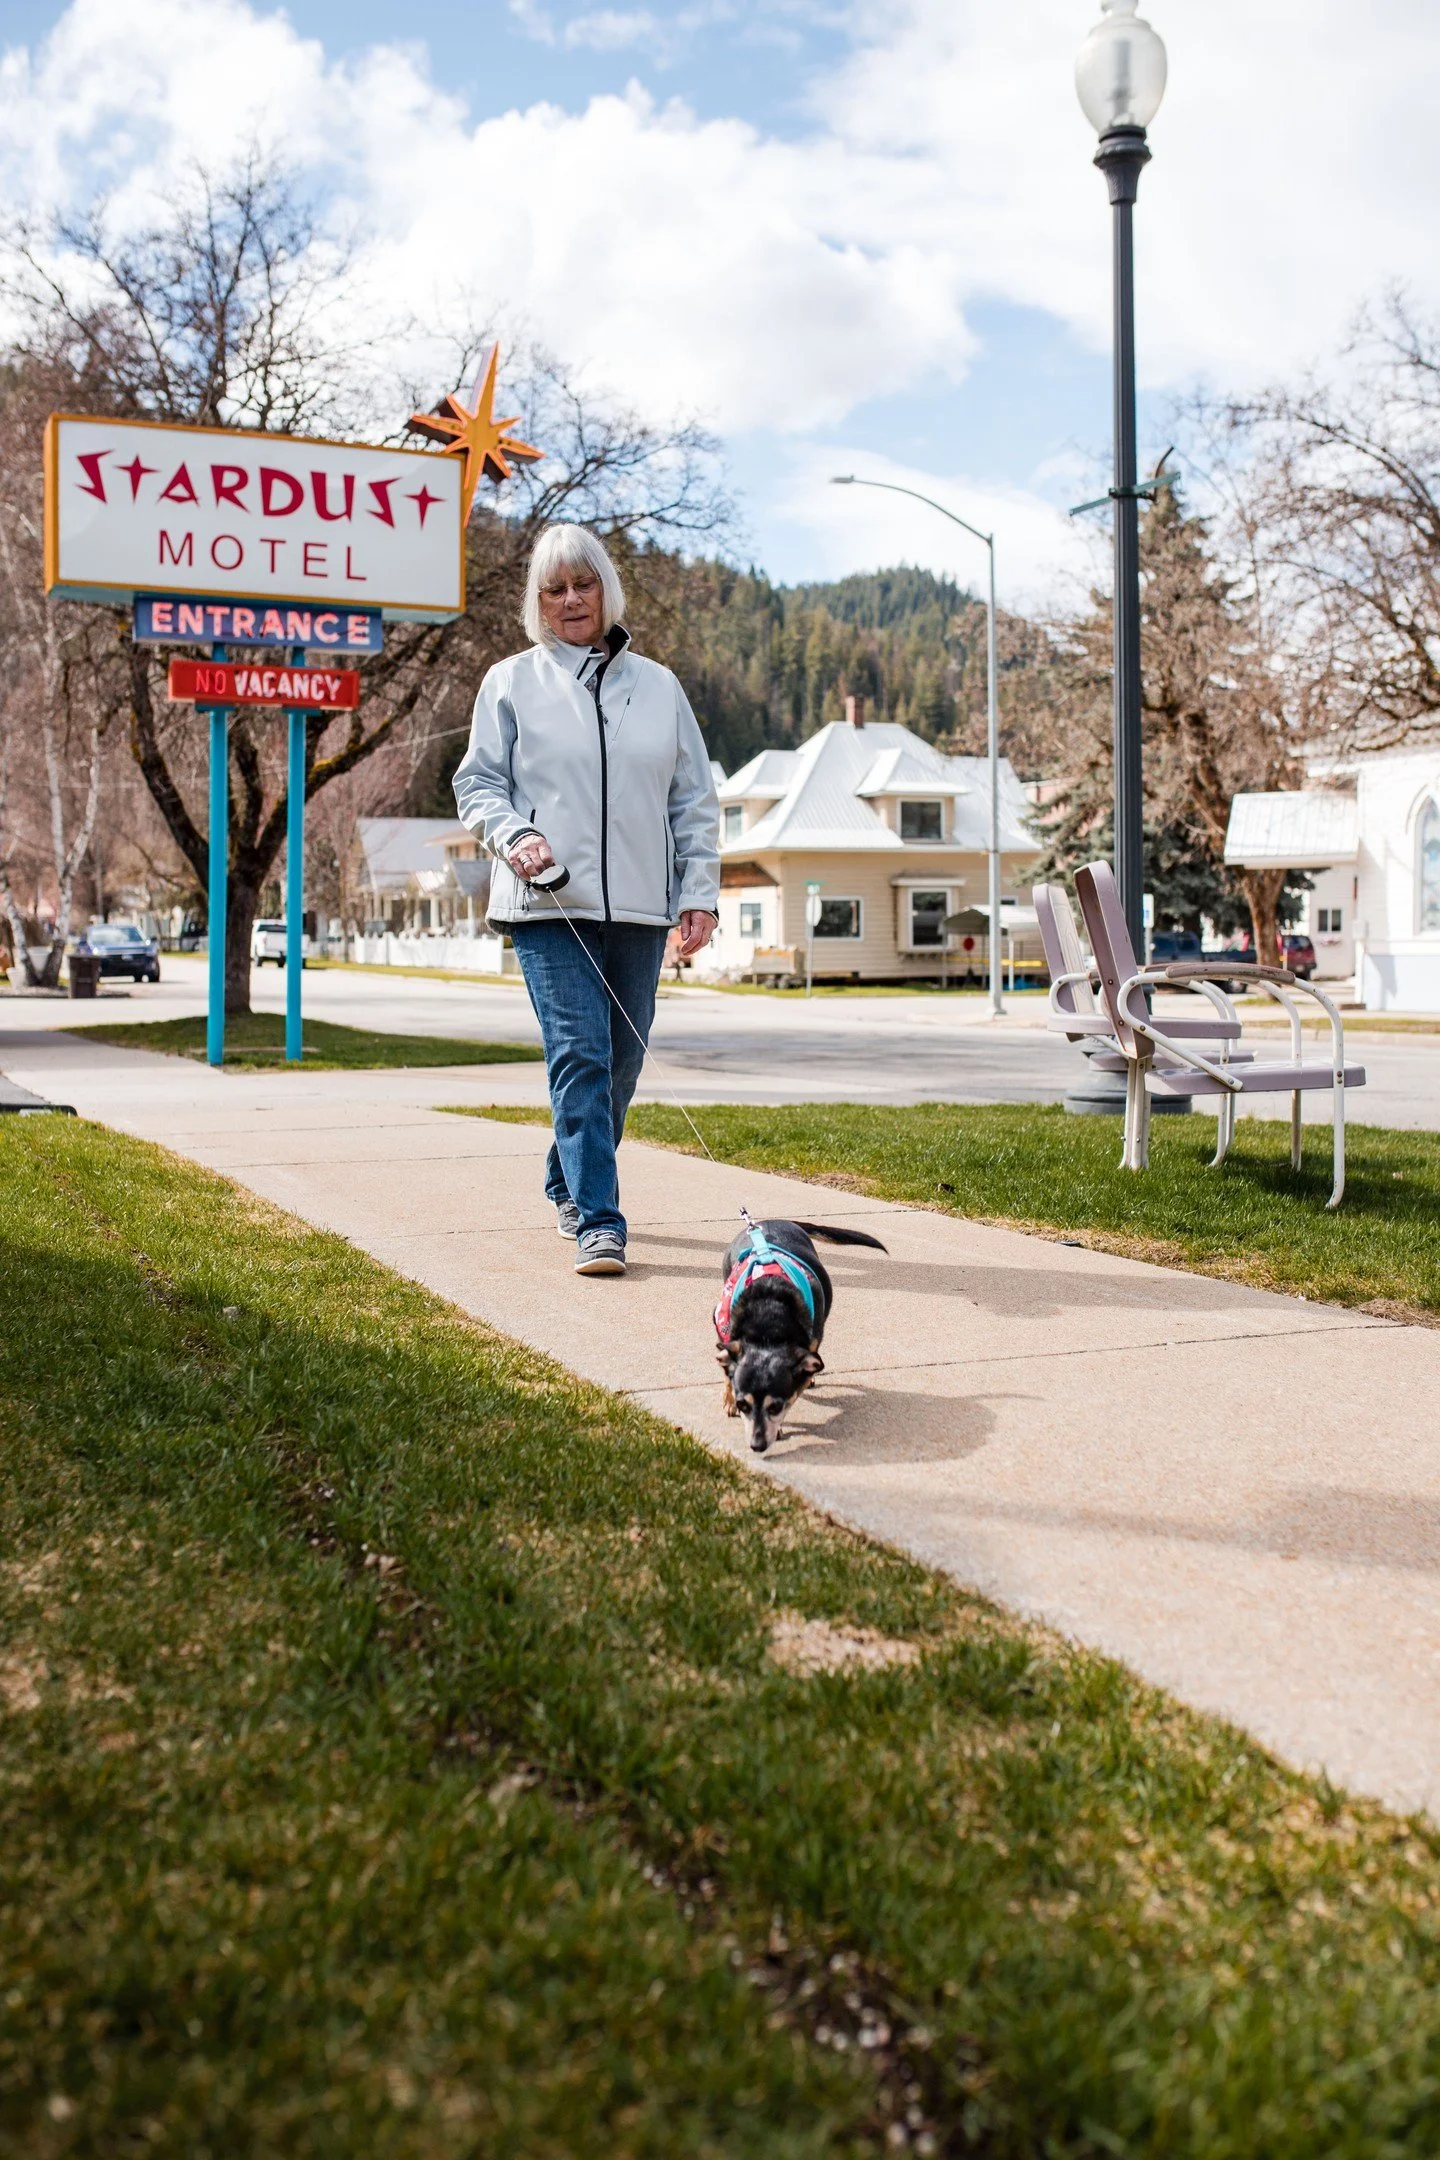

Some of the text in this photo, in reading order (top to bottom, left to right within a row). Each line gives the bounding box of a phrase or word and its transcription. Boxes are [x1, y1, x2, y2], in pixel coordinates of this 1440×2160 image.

[75, 449, 447, 530] STARDUST
[158, 529, 367, 581] MOTEL
[152, 602, 371, 645] ENTRANCE
[196, 669, 342, 701] NO VACANCY
